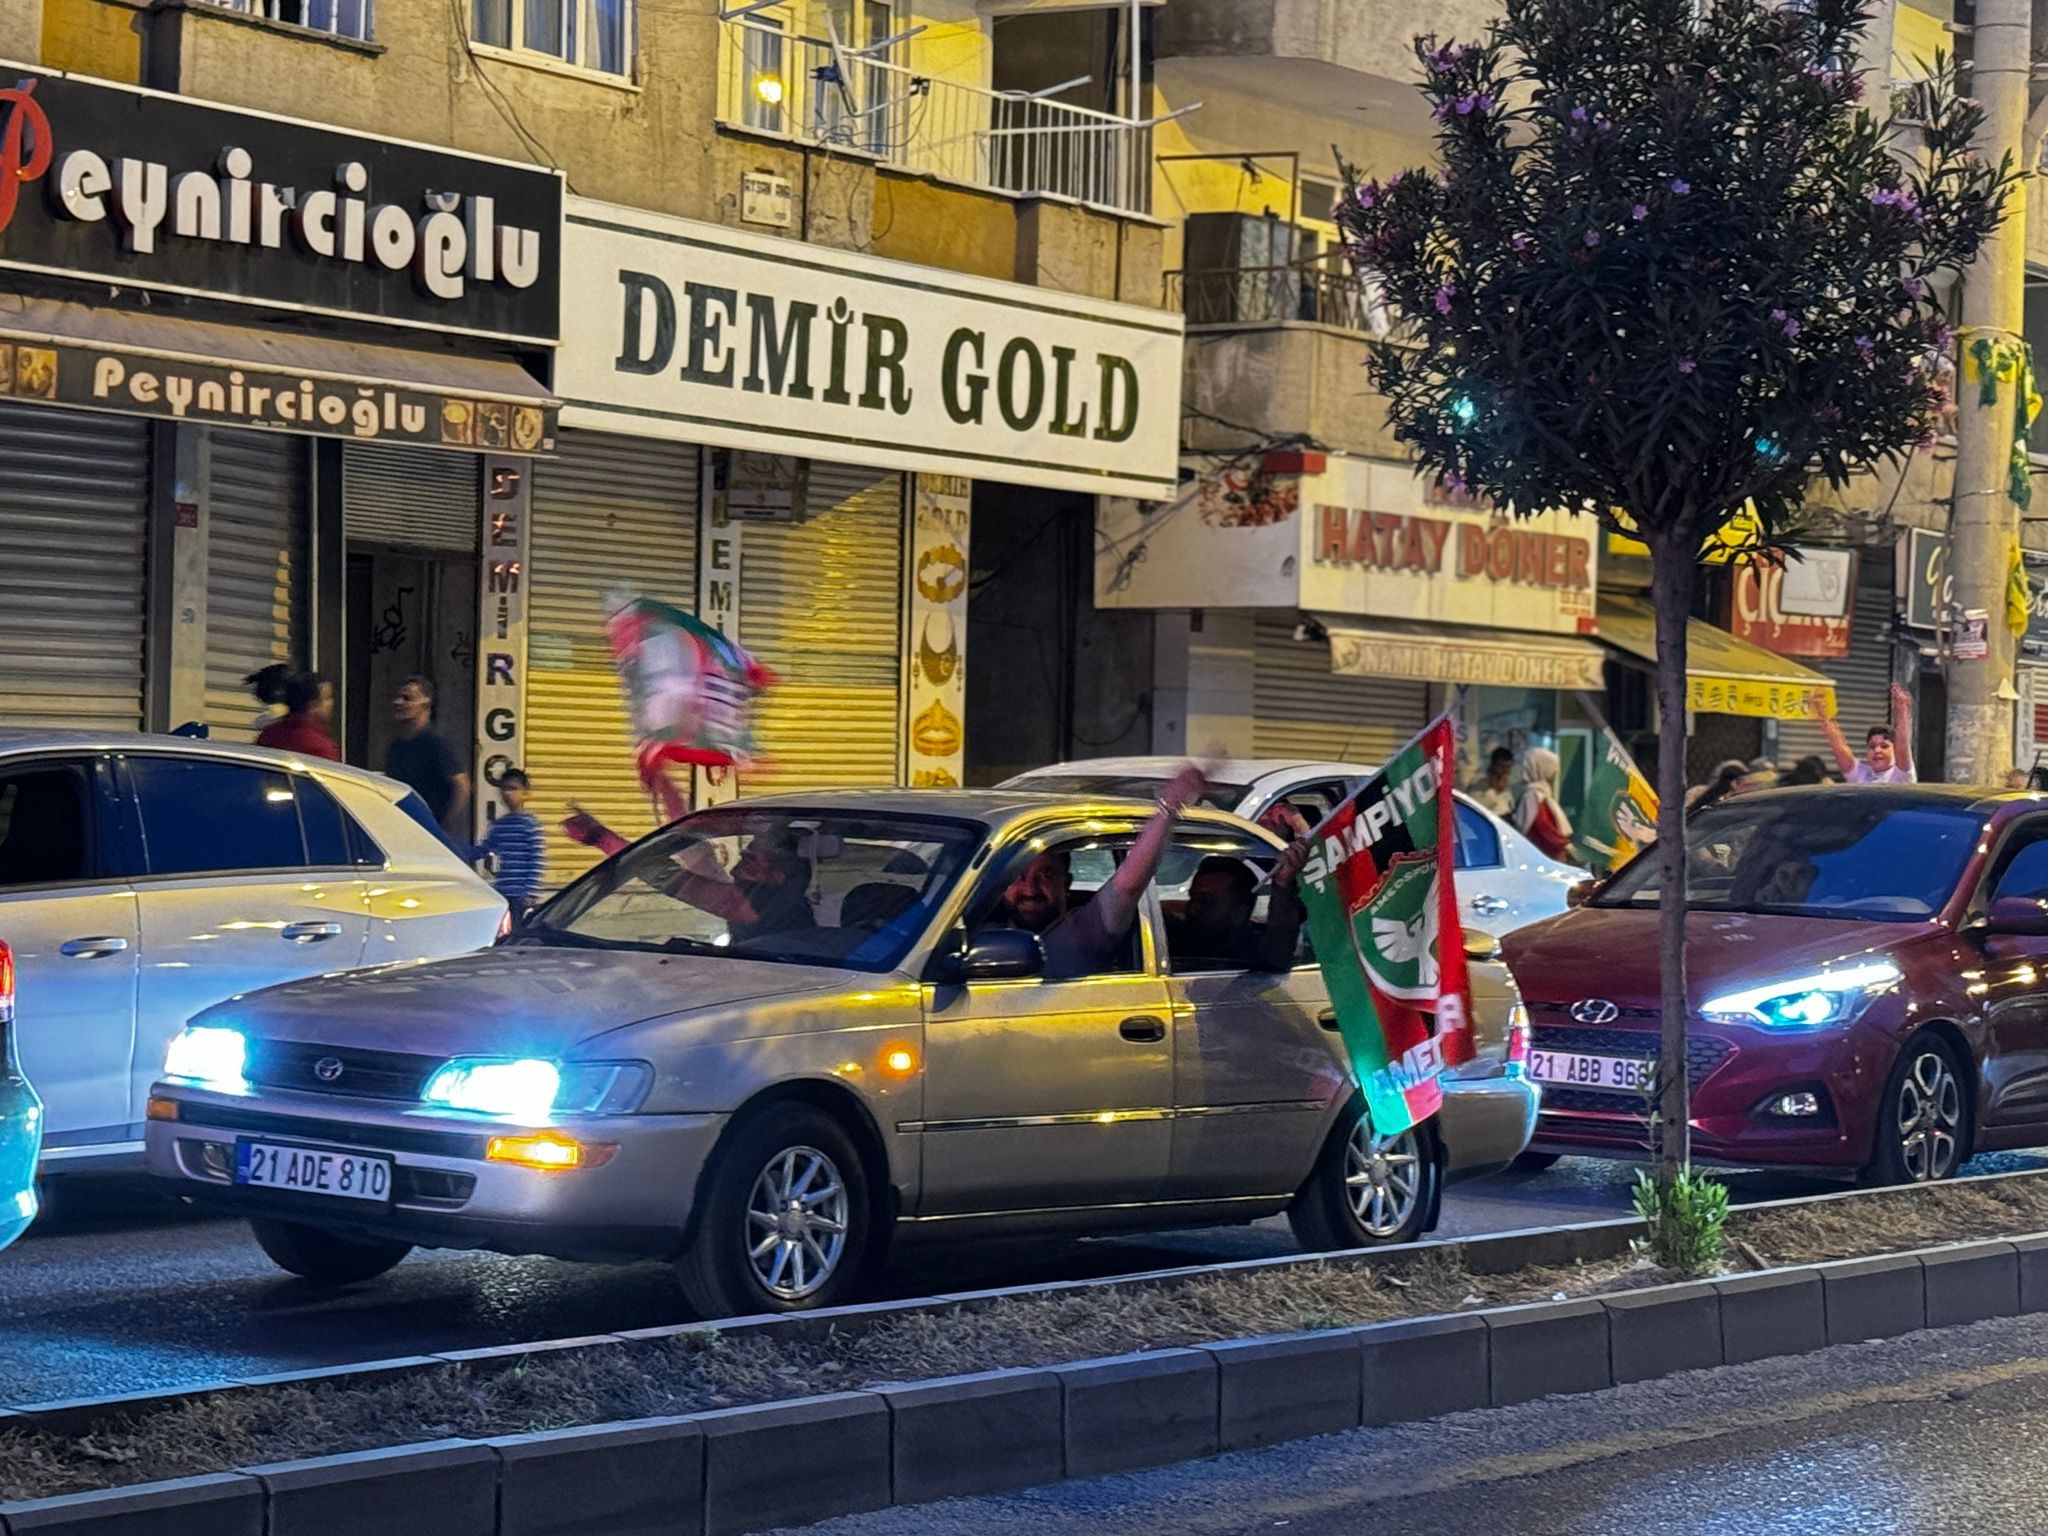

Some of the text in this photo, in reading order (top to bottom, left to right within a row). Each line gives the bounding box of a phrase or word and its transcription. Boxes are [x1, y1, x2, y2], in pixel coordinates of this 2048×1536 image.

[615, 269, 1140, 444] DEMİR GOLD
[93, 357, 426, 438] Peynircioğlu
[1315, 504, 1453, 574] HATAY
[1434, 648, 1497, 681] HATAY
[1532, 1053, 1555, 1079] 21
[1566, 1056, 1602, 1083] ABB
[250, 1148, 279, 1183] 21
[286, 1151, 334, 1190] ADE
[339, 1158, 387, 1195] 810
